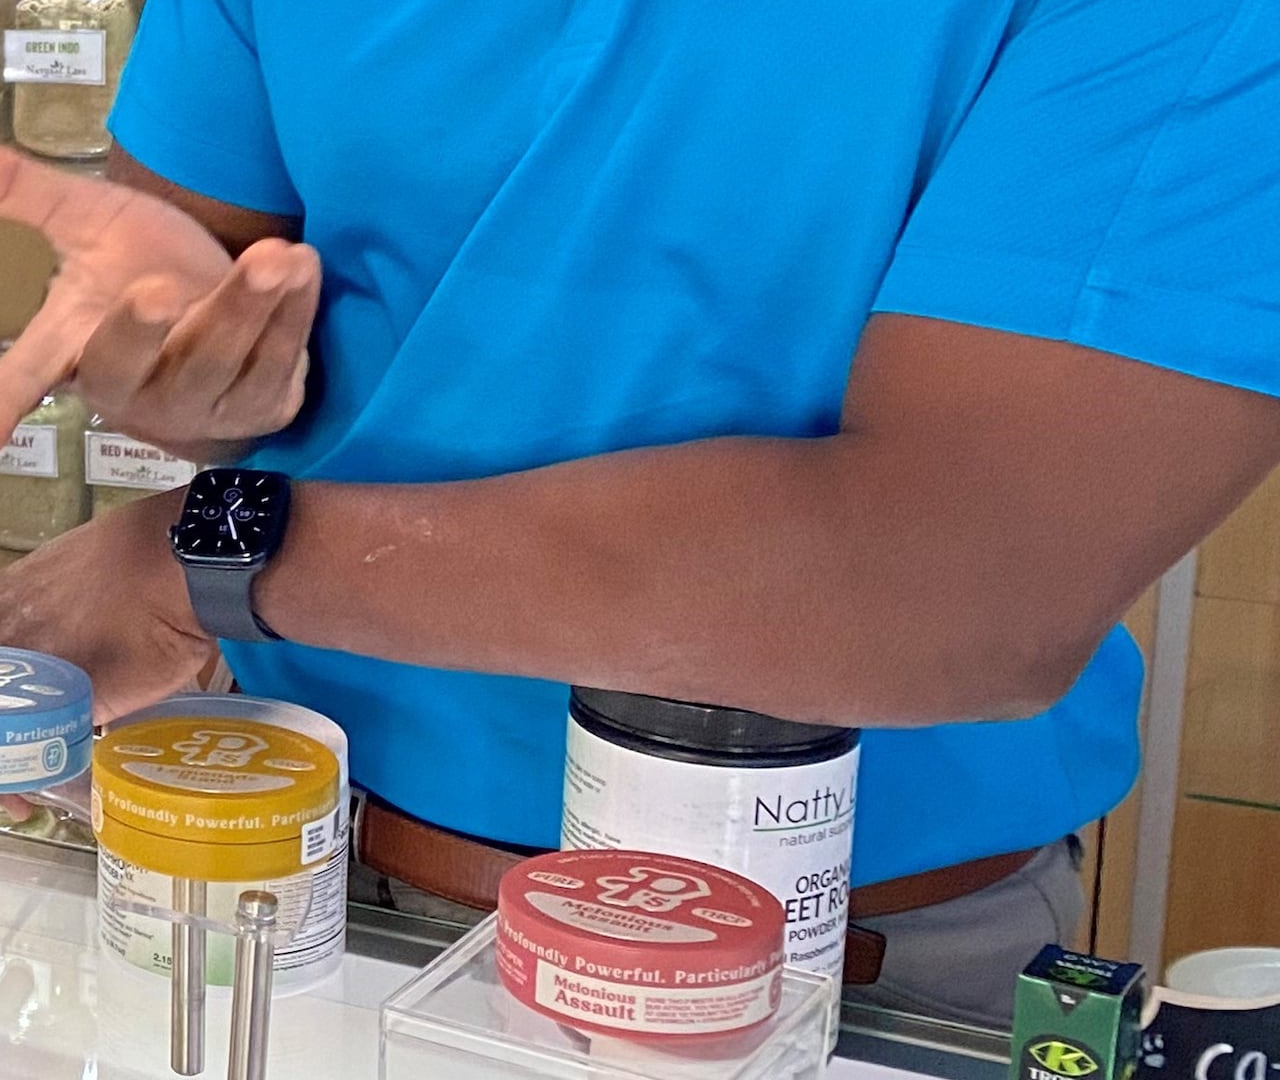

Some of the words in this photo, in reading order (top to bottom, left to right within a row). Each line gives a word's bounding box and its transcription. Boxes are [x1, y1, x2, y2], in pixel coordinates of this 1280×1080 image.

[25, 42, 55, 54] GREEN
[58, 42, 80, 54] INDO
[8, 437, 34, 449] ALAY
[100, 445, 121, 459] RED
[124, 447, 161, 462] MAENG
[6, 721, 78, 743] Particularly
[108, 791, 178, 827] Profoundly
[185, 813, 265, 830] Powerful.
[754, 786, 846, 826] Natty
[779, 827, 827, 848] natural
[534, 871, 580, 888] PURE
[569, 910, 654, 935] Assault
[699, 908, 748, 924] THCP
[789, 917, 837, 943] POWDER
[503, 924, 568, 971] Profoundly
[575, 956, 666, 984] Powerful.
[675, 959, 767, 984] Particularly
[554, 974, 637, 1004] Melonious
[555, 991, 637, 1022] Assault
